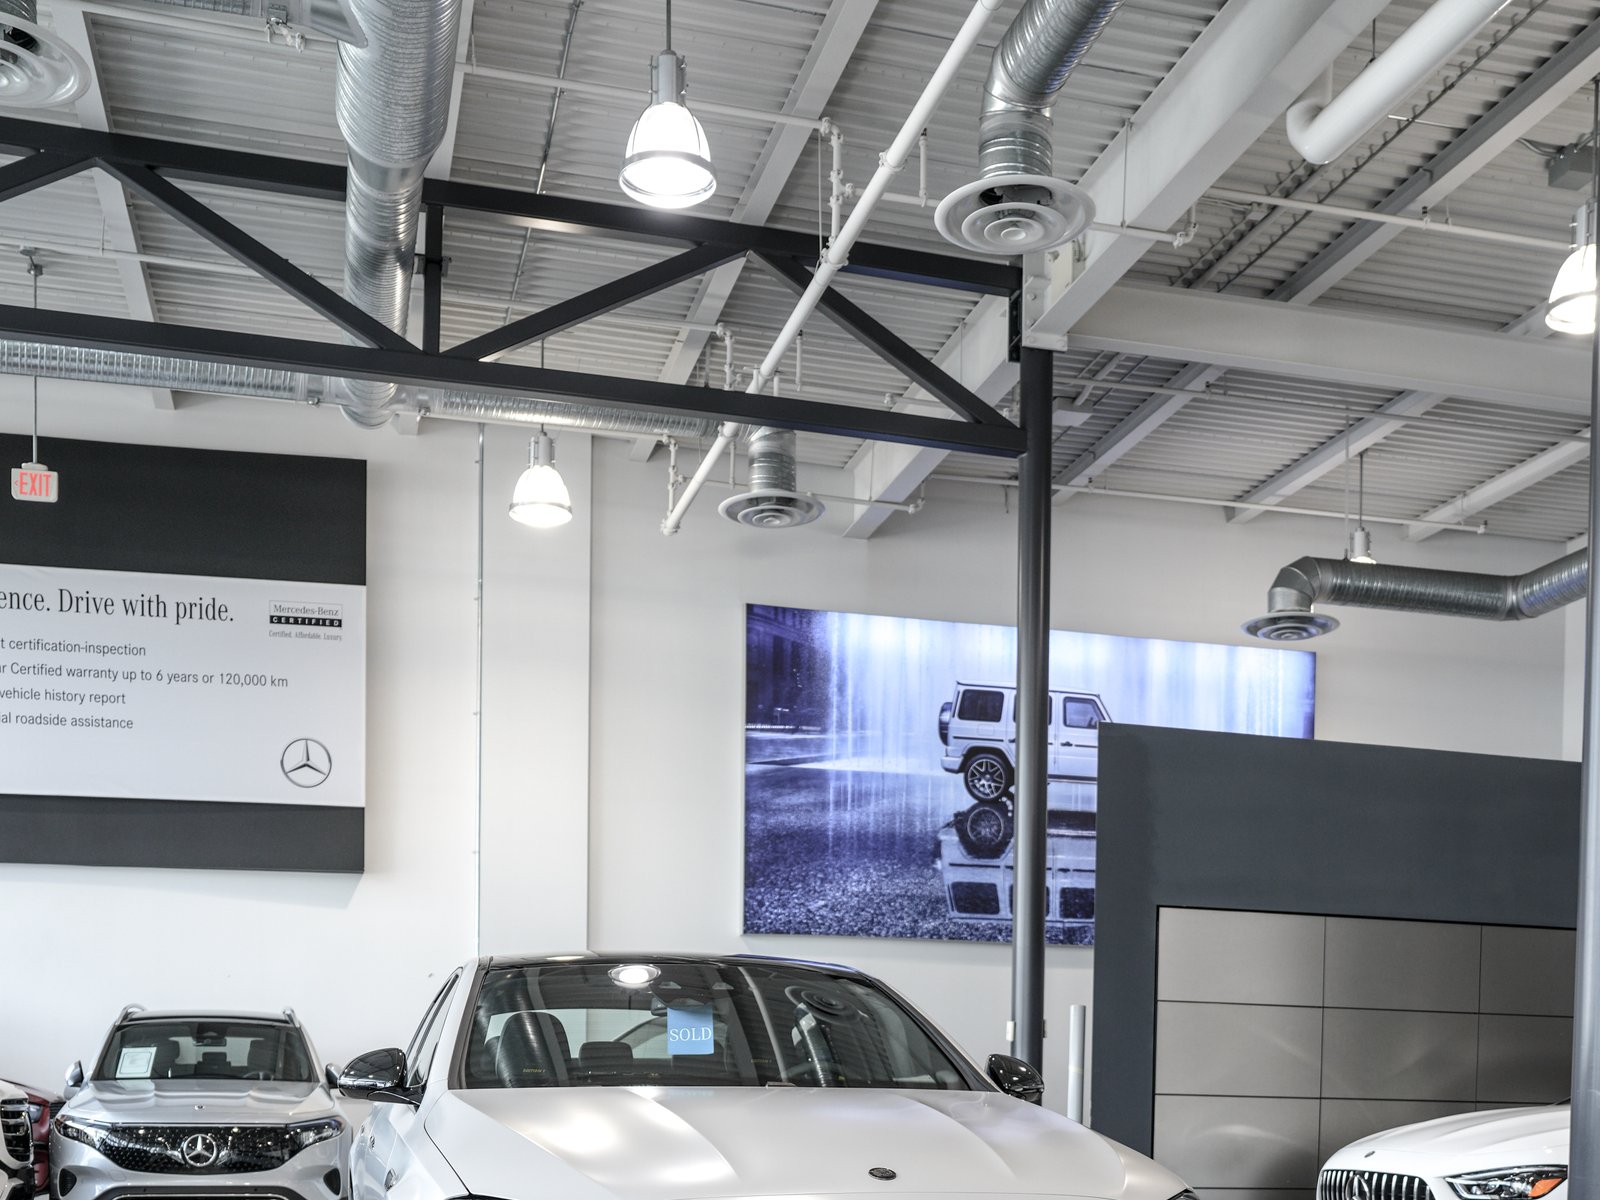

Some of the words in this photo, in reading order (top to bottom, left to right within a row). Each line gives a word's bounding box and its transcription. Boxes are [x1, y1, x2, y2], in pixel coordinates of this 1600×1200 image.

[19, 471, 51, 497] EXIT
[58, 588, 115, 616] Drive
[122, 594, 168, 618] with
[175, 597, 234, 625] pride.
[273, 604, 339, 617] Mercedes-Benz
[272, 616, 339, 626] CERTIFIED
[8, 638, 147, 657] certification-inspection
[10, 662, 62, 677] Certified
[66, 667, 119, 682] warranty
[122, 670, 137, 683] up
[141, 669, 152, 681] to
[156, 669, 163, 681] 6
[167, 672, 199, 685] years
[202, 673, 215, 684] or
[219, 672, 267, 687] 120,000
[270, 675, 288, 687] km
[0, 687, 41, 701] vehicle
[44, 689, 86, 705] history
[89, 692, 126, 706] report
[15, 713, 67, 727] roadside
[71, 715, 134, 729] assistance
[669, 1027, 712, 1042] SOLD
